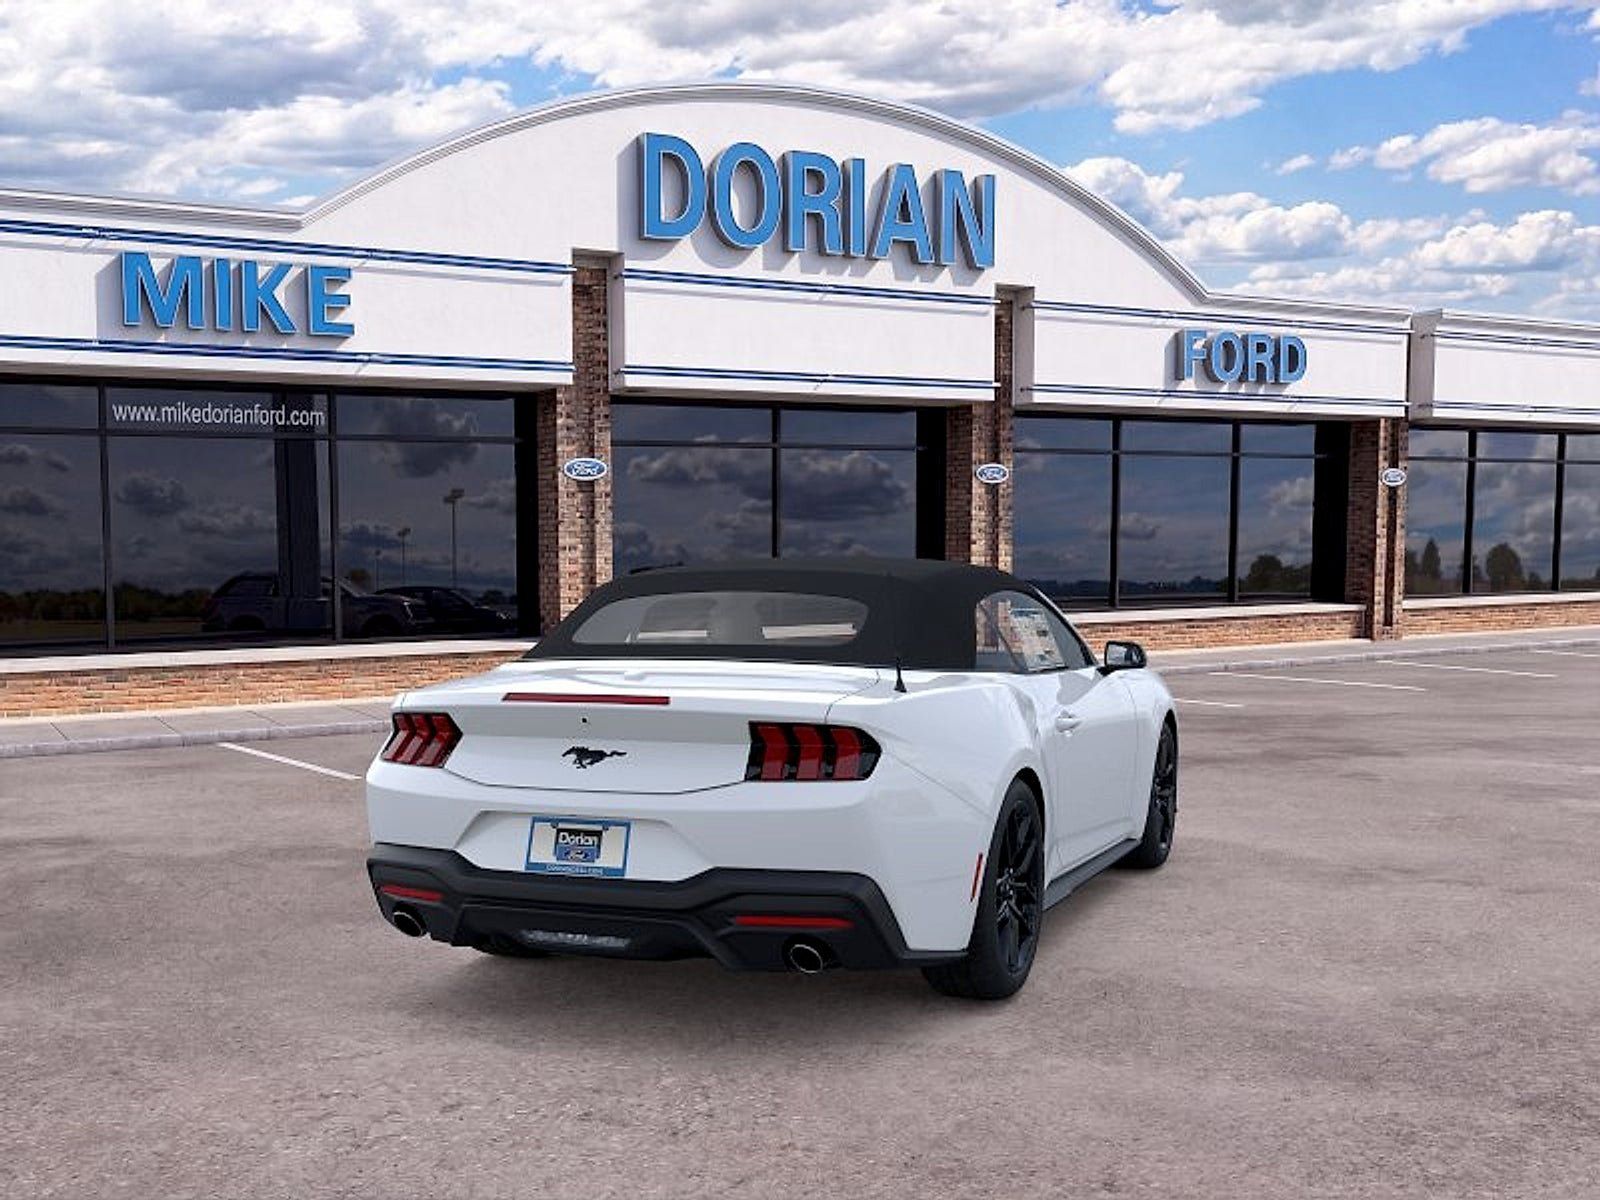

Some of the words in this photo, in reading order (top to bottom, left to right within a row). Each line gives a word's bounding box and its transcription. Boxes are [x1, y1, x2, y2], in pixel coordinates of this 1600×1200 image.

[640, 132, 996, 270] DORIAN
[121, 251, 355, 337] MIKE
[1178, 329, 1308, 384] FORD
[112, 402, 326, 427] www.mikedorianford.com
[558, 832, 598, 846] Dorian
